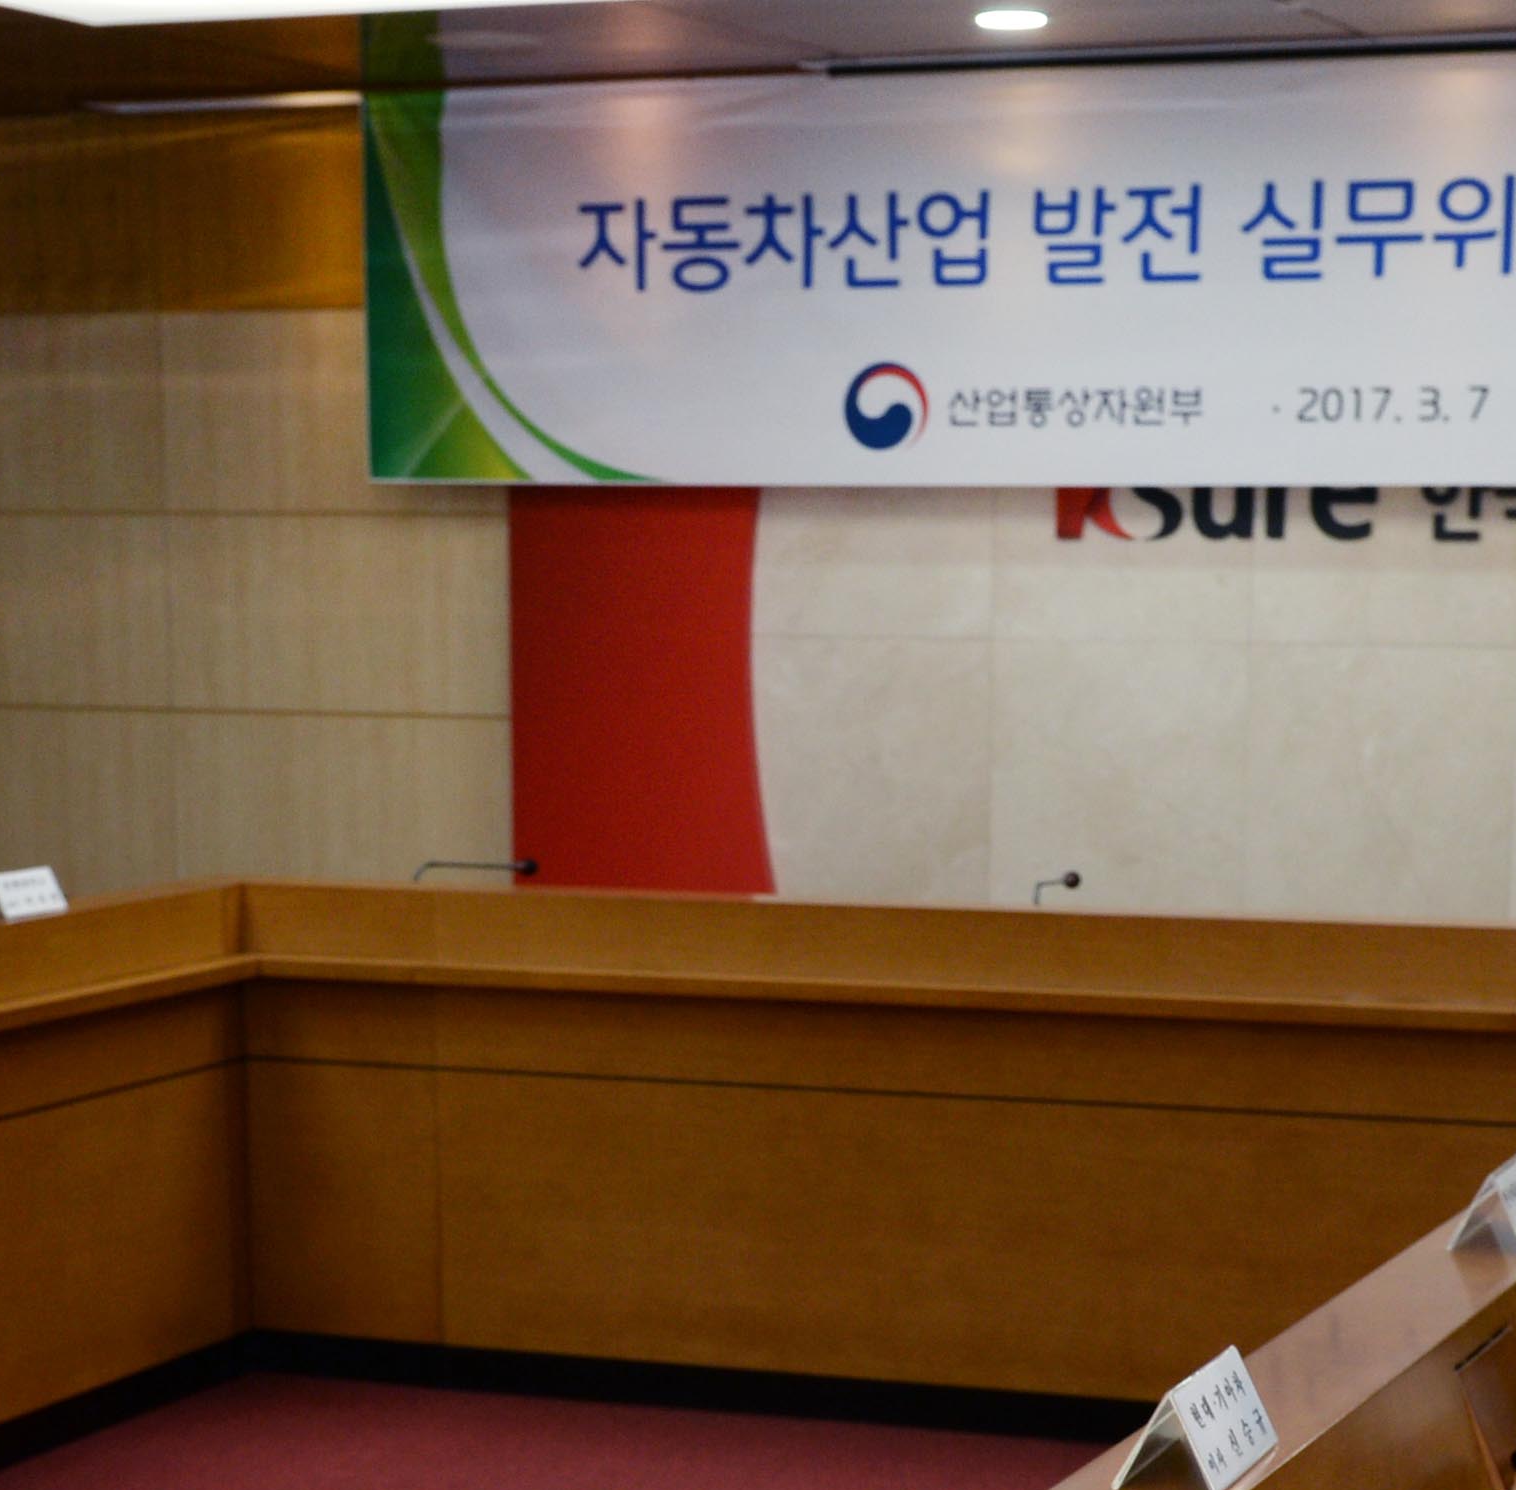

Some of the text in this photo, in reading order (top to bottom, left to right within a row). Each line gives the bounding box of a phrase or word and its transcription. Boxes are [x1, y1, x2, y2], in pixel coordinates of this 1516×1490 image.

[577, 191, 992, 294] 자동차산업
[1032, 184, 1202, 286] 발전
[947, 387, 1204, 429] 산업통상자원부
[1297, 386, 1402, 423] 2017.
[1468, 385, 1490, 422] 7
